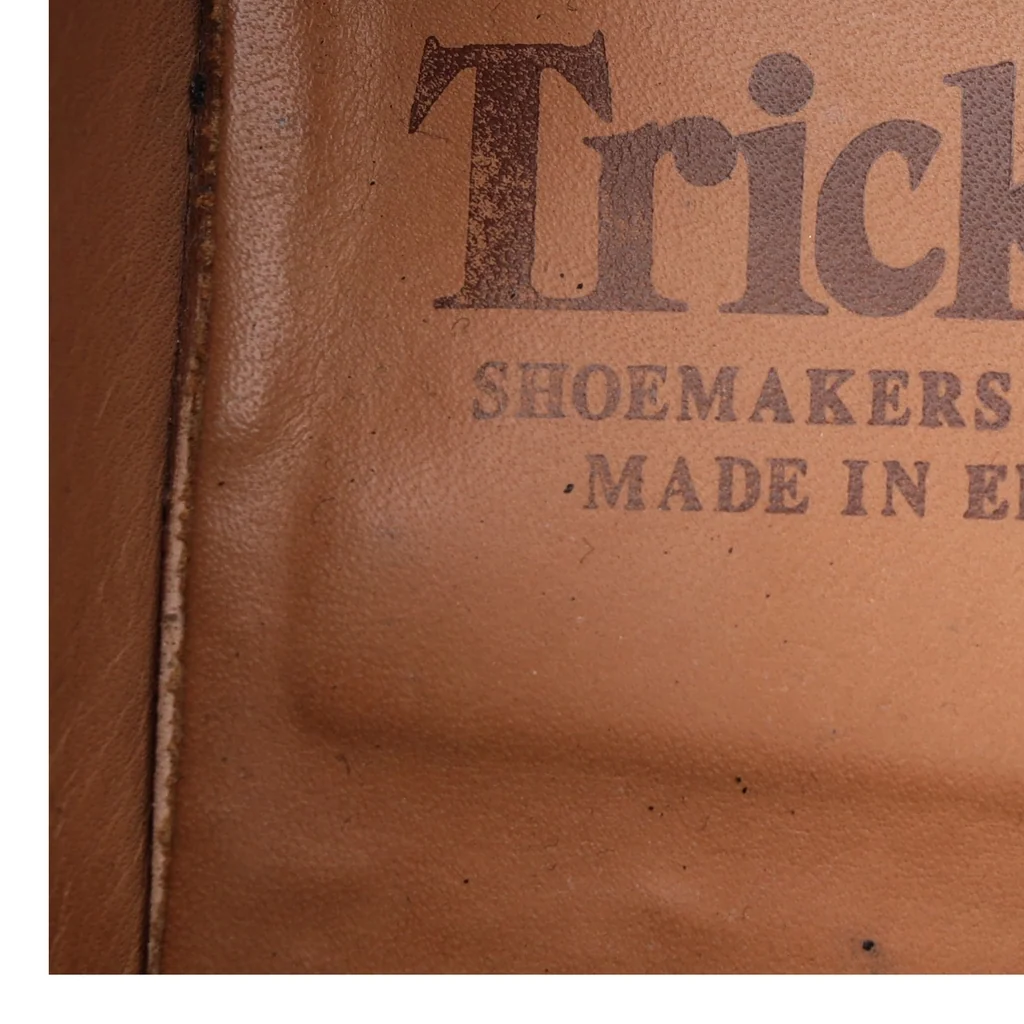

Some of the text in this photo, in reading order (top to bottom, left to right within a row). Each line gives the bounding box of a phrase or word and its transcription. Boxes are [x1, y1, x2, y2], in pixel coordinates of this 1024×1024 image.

[471, 360, 1011, 432] SHOEMAKERS
[582, 452, 810, 516] MADE
[841, 460, 930, 518] IN
